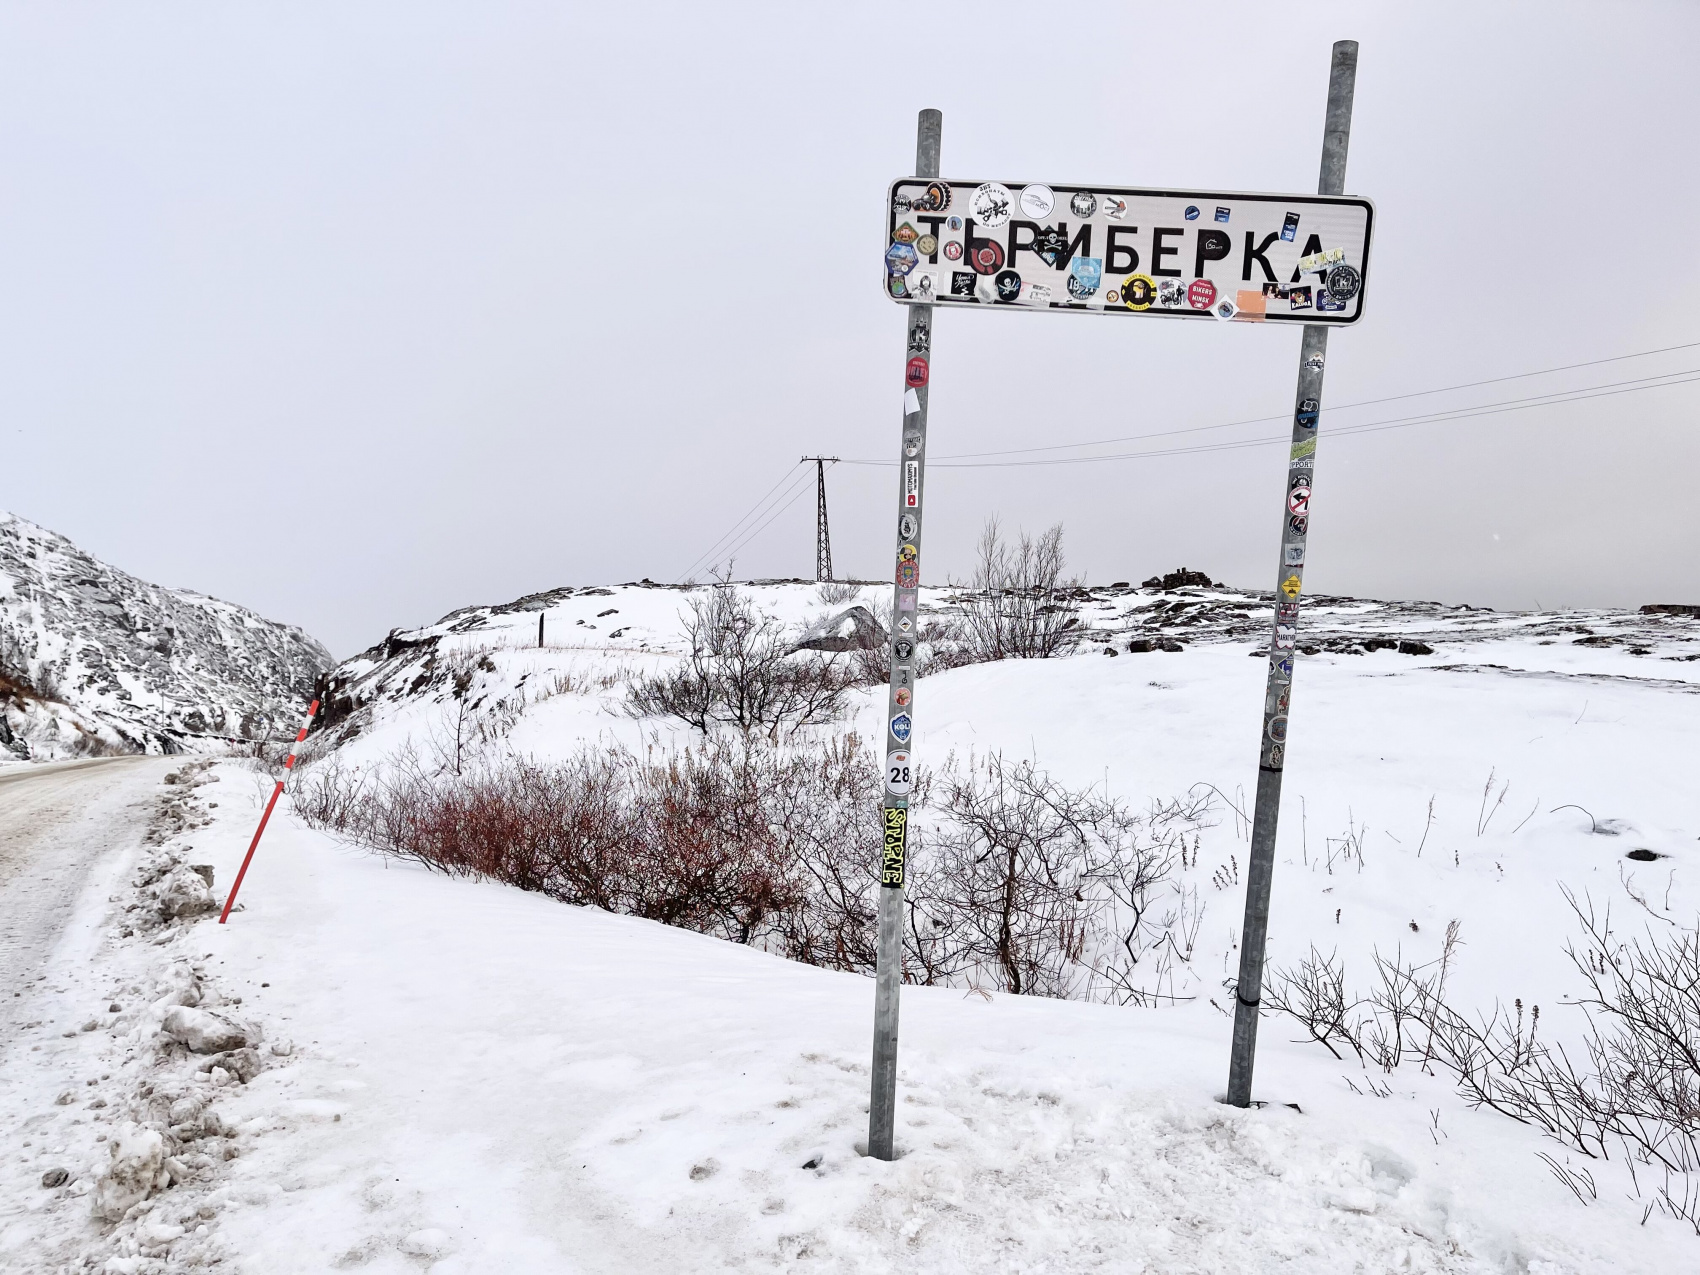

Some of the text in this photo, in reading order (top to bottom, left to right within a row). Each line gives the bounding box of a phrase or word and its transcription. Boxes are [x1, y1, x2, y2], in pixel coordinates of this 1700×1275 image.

[1192, 285, 1213, 296] BIKERS
[1191, 294, 1210, 304] MINSK
[894, 723, 911, 731] KOLI
[890, 766, 910, 784] 28
